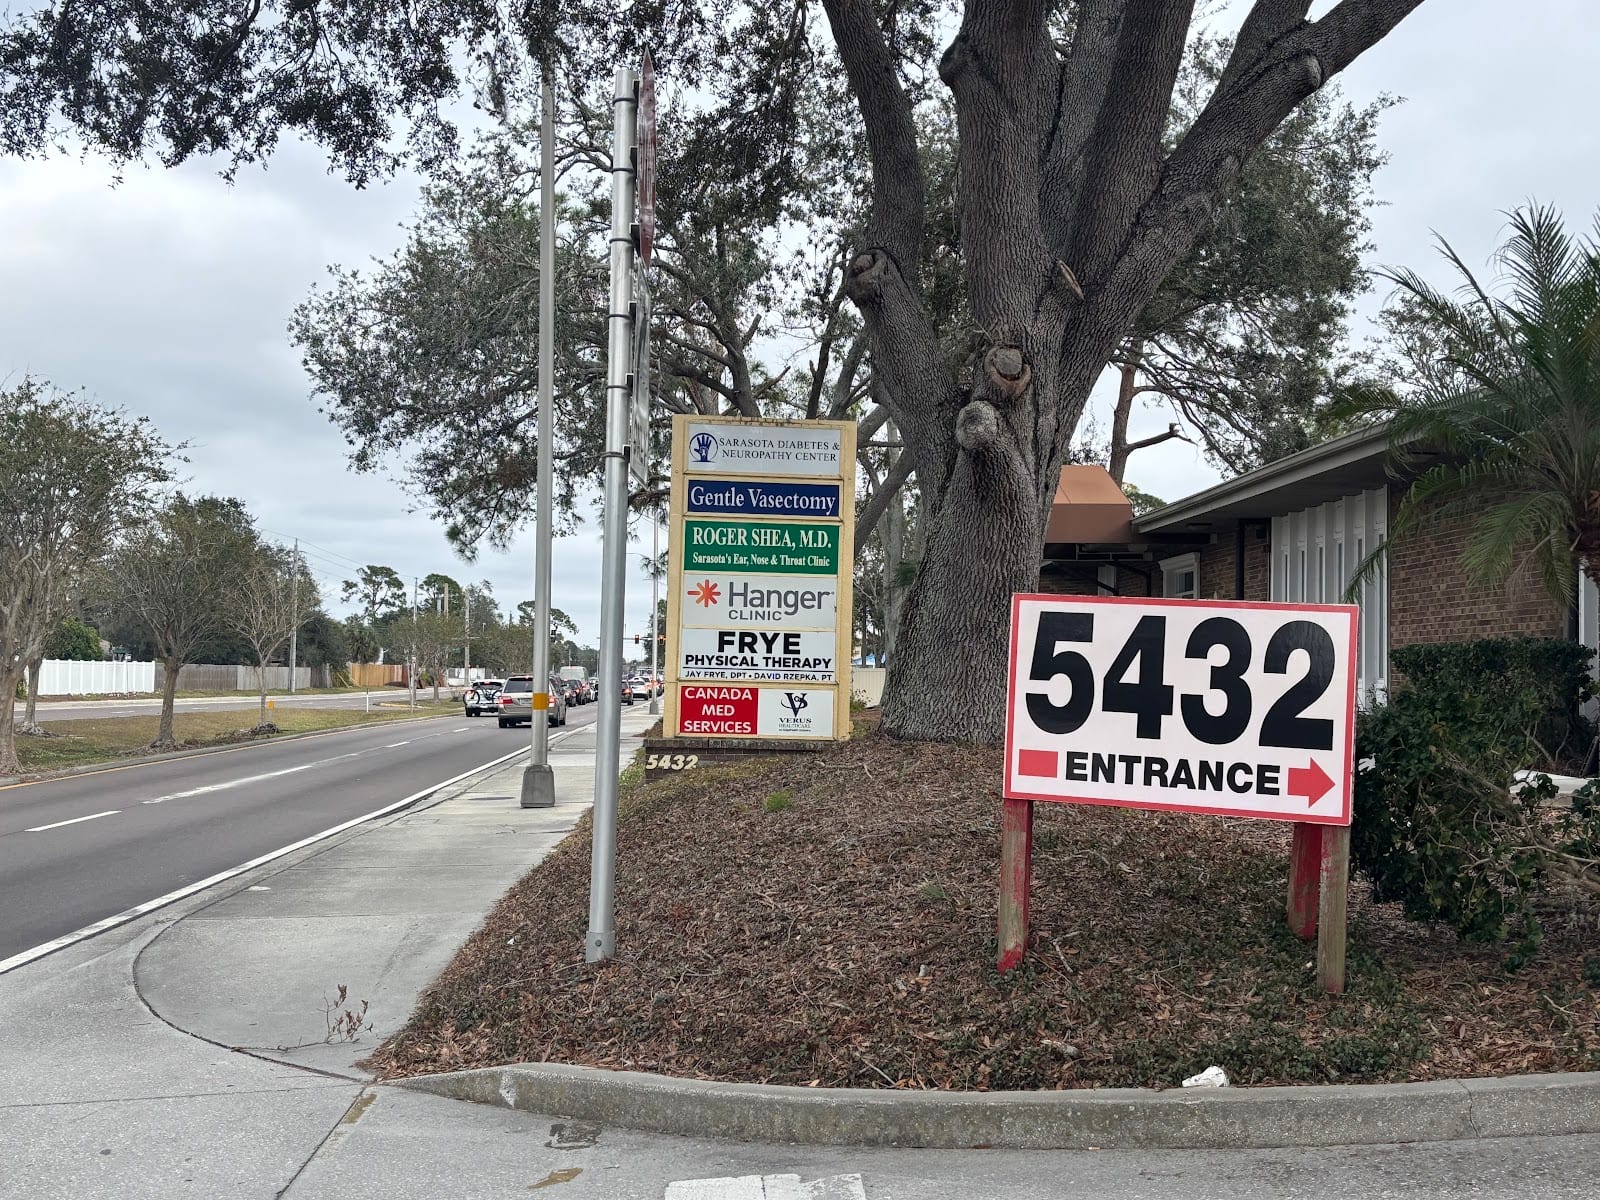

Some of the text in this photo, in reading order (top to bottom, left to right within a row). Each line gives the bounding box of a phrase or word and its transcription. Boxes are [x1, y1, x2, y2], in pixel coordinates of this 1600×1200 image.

[719, 438, 840, 450] SARASOTA DIABETES &
[722, 450, 836, 461] NEUROPATHY CENTER
[691, 486, 835, 515] Gentle Vasectomy
[692, 527, 831, 550] ROGER SHEA, M.D.
[693, 552, 830, 566] Sarasota's Ear, Nose & Throat Clinic
[729, 582, 830, 615] Hanger
[729, 610, 782, 621] CLINIC
[718, 632, 801, 655] FRYE
[685, 655, 832, 669] PHYSICAL THERAPY
[704, 671, 728, 679] FRYE,
[1026, 611, 1336, 751] 5432
[685, 688, 752, 701] CANADA
[702, 705, 735, 716] MED
[684, 720, 751, 733] SERVICES
[646, 755, 699, 770] 5432
[1066, 751, 1281, 796] ENTRANCE
